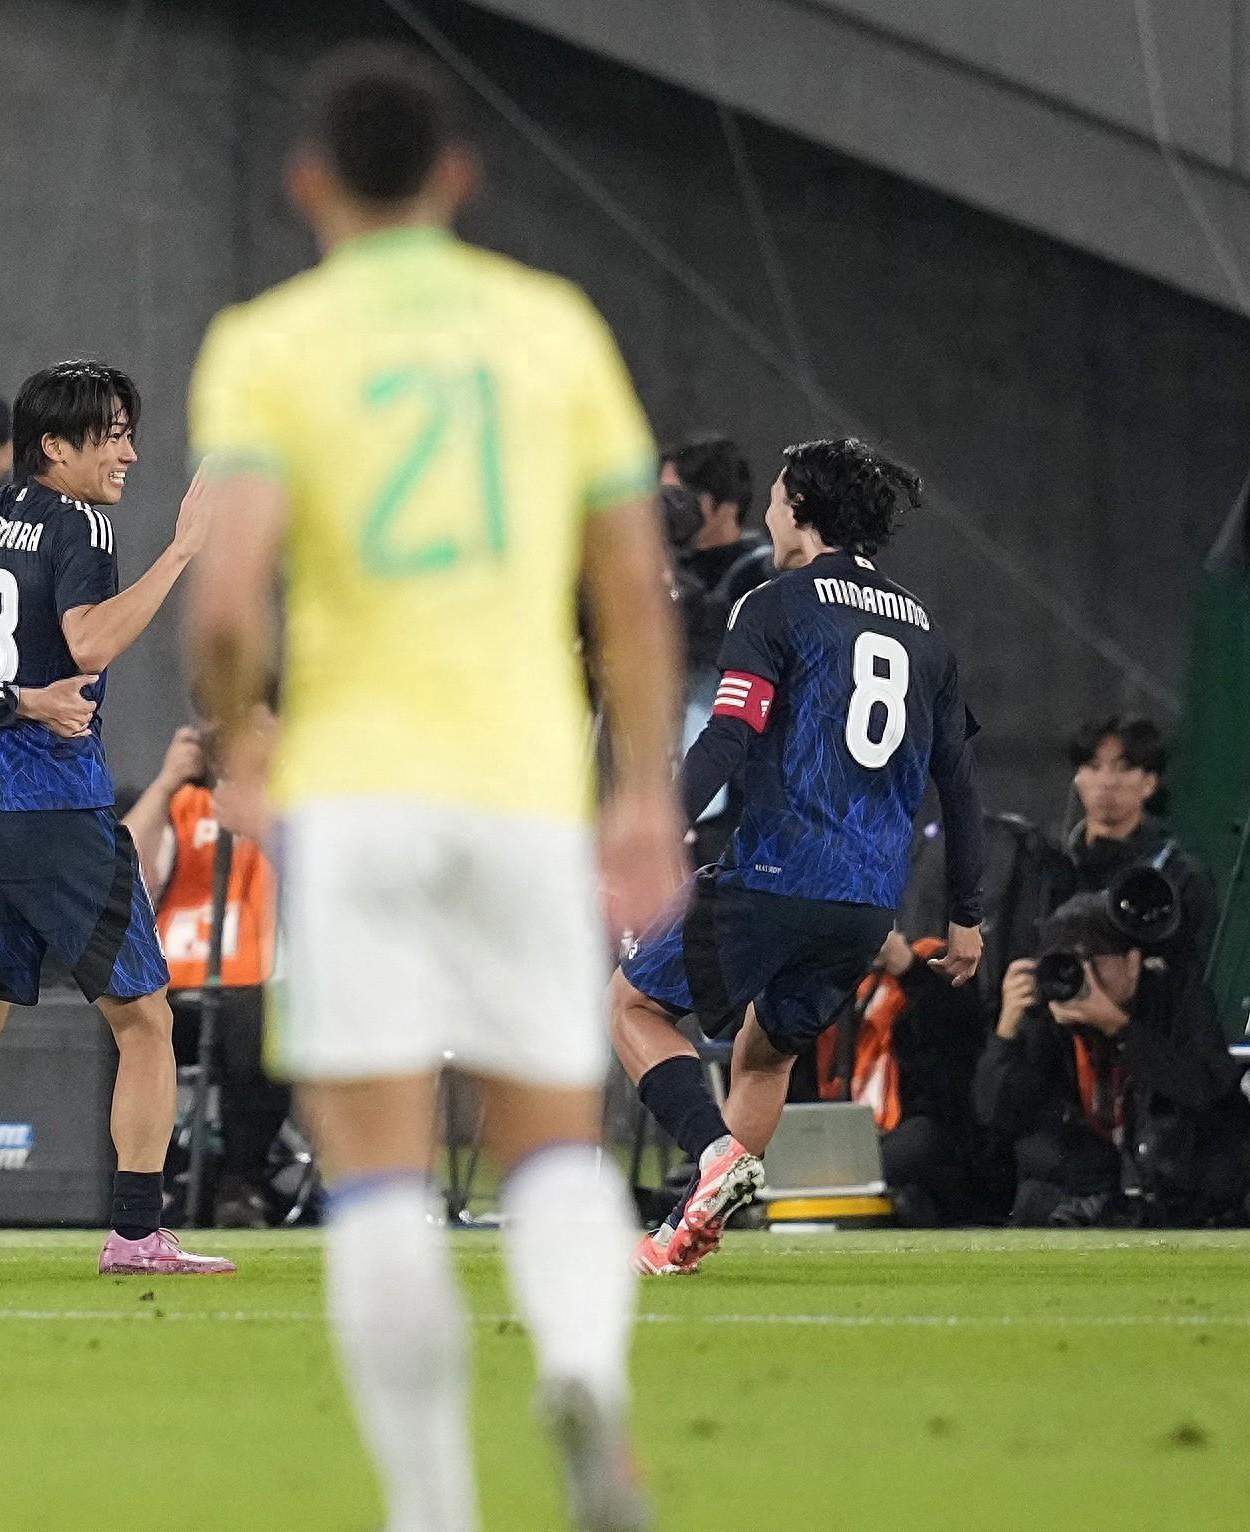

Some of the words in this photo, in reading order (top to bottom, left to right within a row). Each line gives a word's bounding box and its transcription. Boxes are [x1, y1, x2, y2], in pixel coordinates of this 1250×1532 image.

[359, 365, 510, 575] 21
[813, 578, 930, 631] MINAMINO
[845, 631, 910, 769] 8
